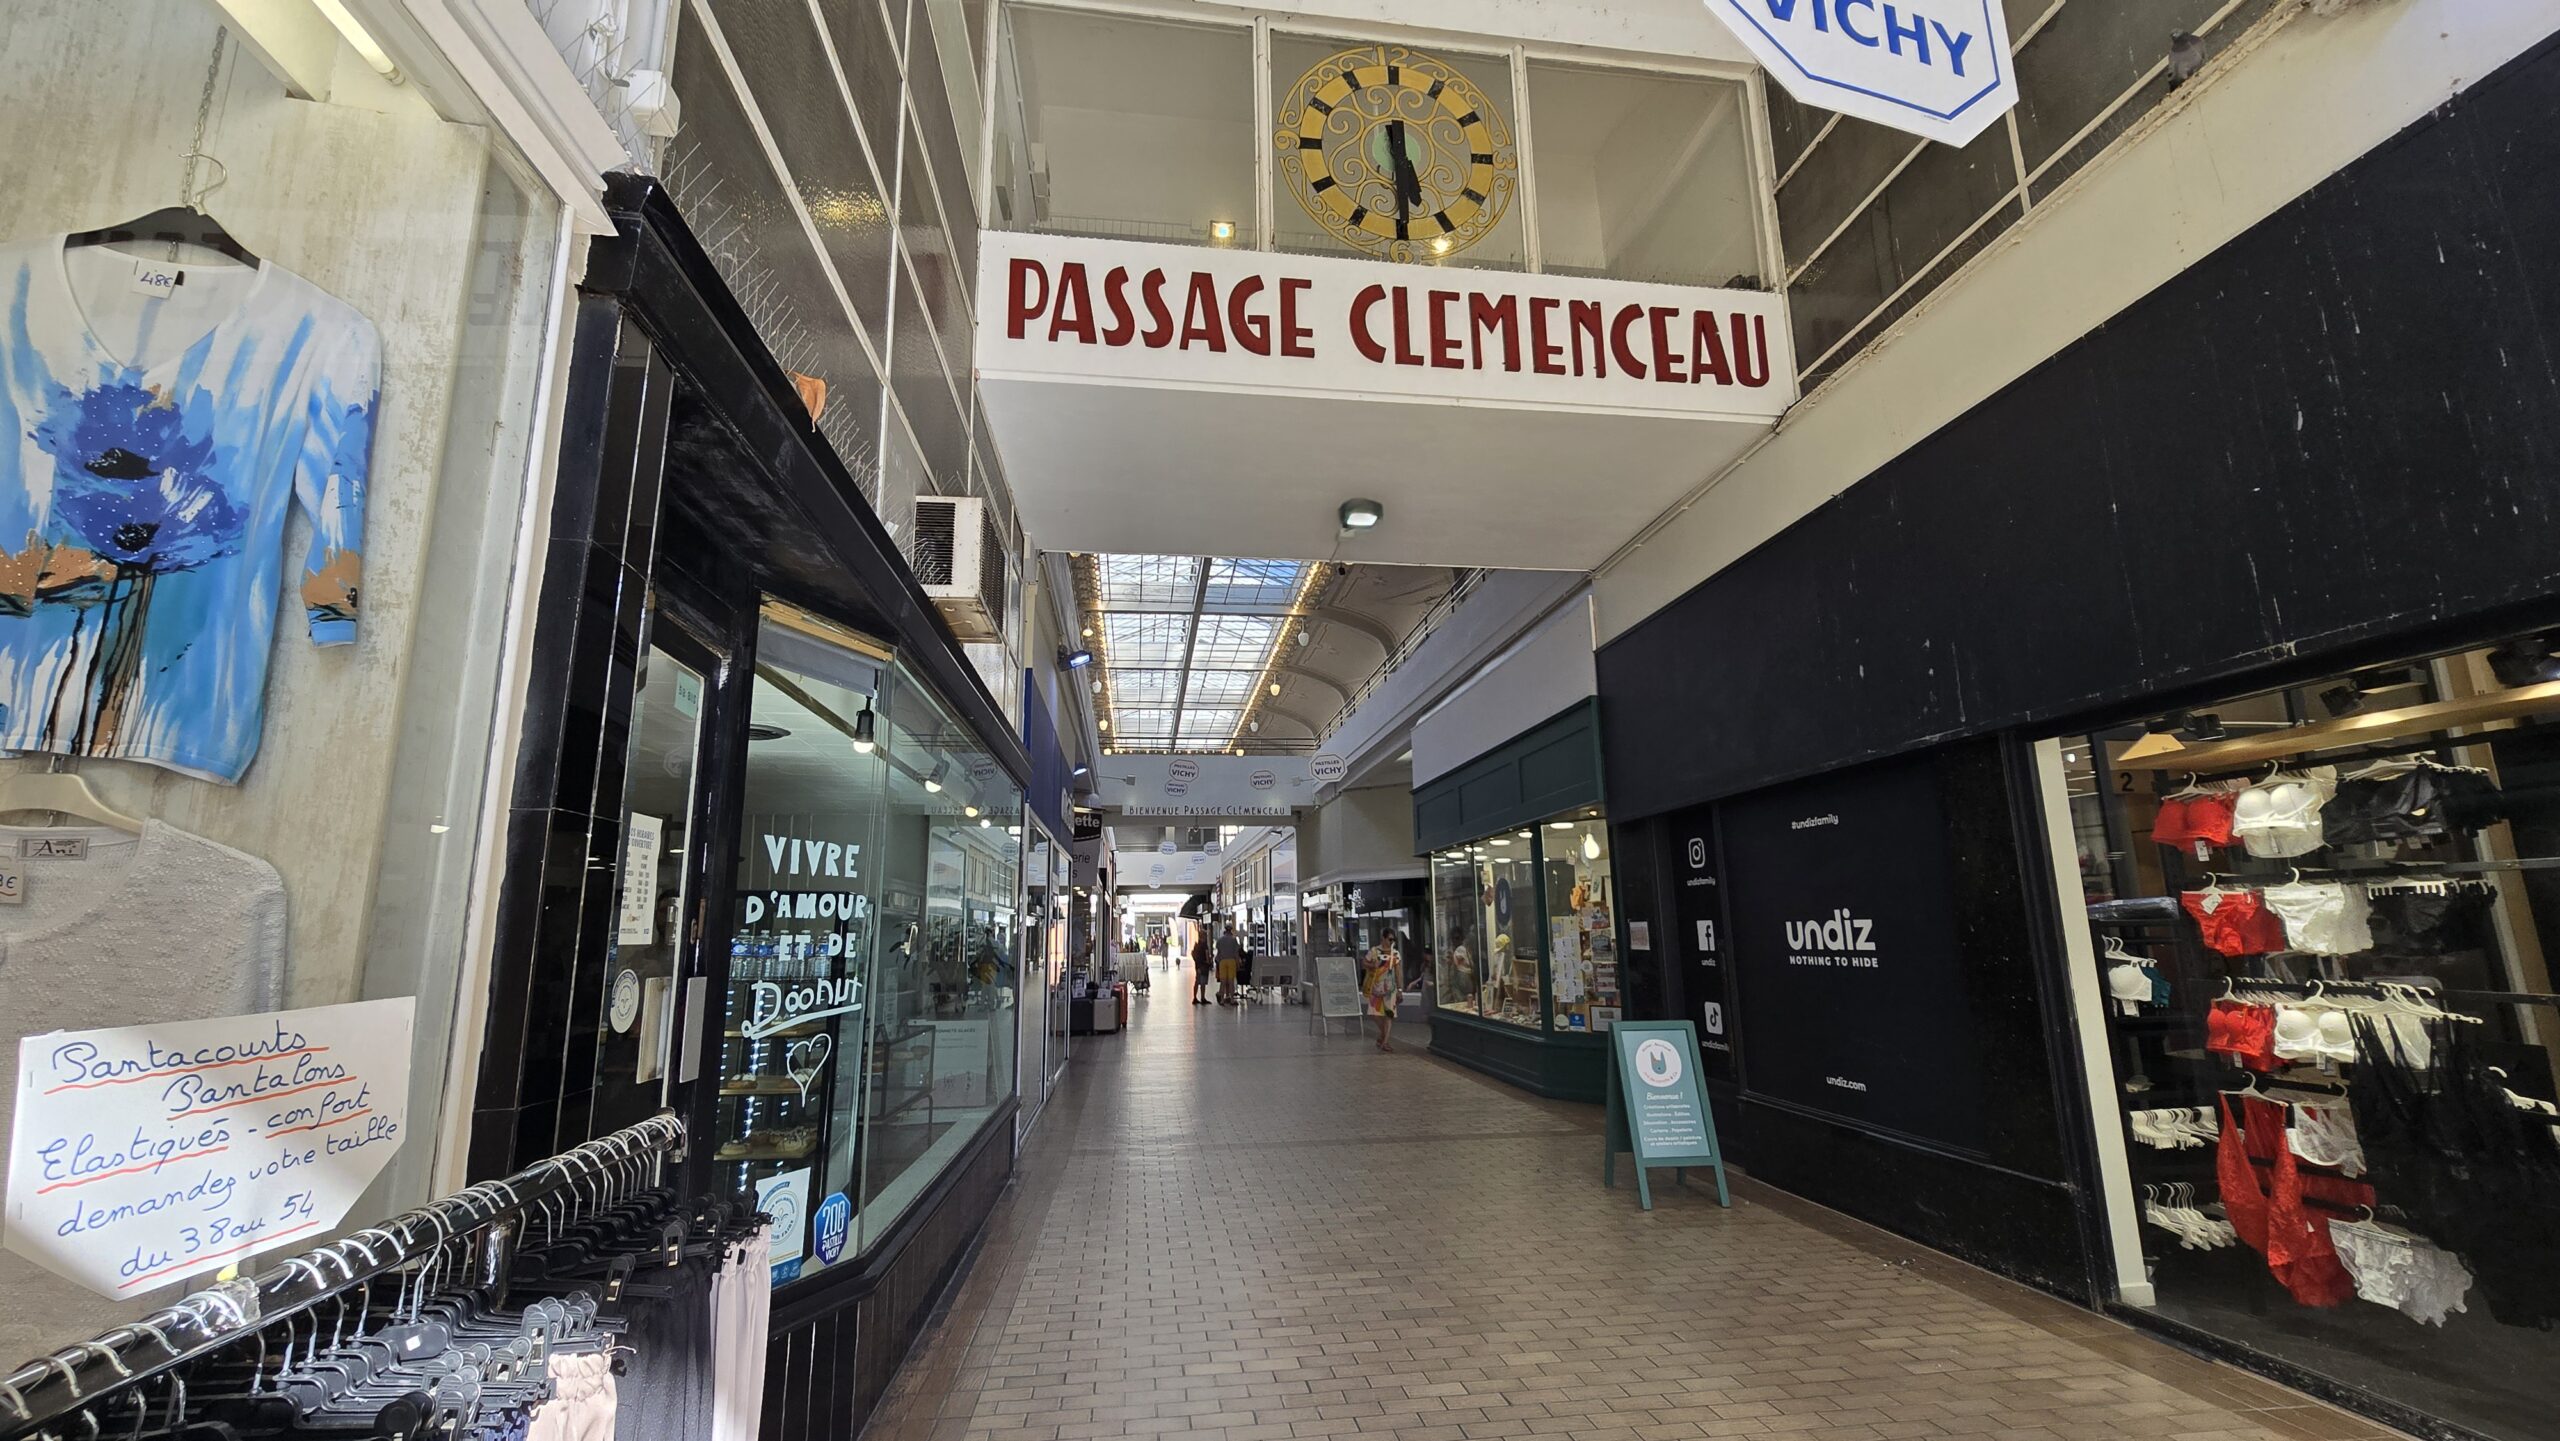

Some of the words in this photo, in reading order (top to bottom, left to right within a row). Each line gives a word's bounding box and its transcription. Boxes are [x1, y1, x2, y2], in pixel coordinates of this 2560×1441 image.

[140, 271, 174, 288] 48€
[1007, 257, 1316, 359] PASSAGE
[1349, 283, 1771, 388] CLEMENCEAU
[1171, 769, 1197, 778] VICHY
[1314, 766, 1343, 776] VICHY
[1315, 759, 1340, 767] PASTILLES
[2120, 772, 2135, 792] 2
[1129, 805, 1180, 815] BIENVENUE
[1184, 805, 1221, 815] PASSAGE
[763, 834, 860, 878] VIVRE
[745, 891, 868, 923] D'AMOUR
[1785, 908, 1877, 951] undiz
[779, 934, 812, 961] ET
[827, 933, 857, 958] DE
[1789, 955, 1831, 966] NOTHING
[1834, 956, 1848, 967] TO
[1852, 957, 1879, 968] HIDE
[52, 1020, 307, 1083] Pantacourts
[162, 1053, 346, 1112] Pantalons
[1826, 1075, 1867, 1092] undiz.com
[57, 1170, 237, 1237] demandez
[249, 1147, 317, 1181] votre
[326, 1115, 398, 1156] taille
[120, 1246, 173, 1278] du
[279, 1189, 315, 1221] 54
